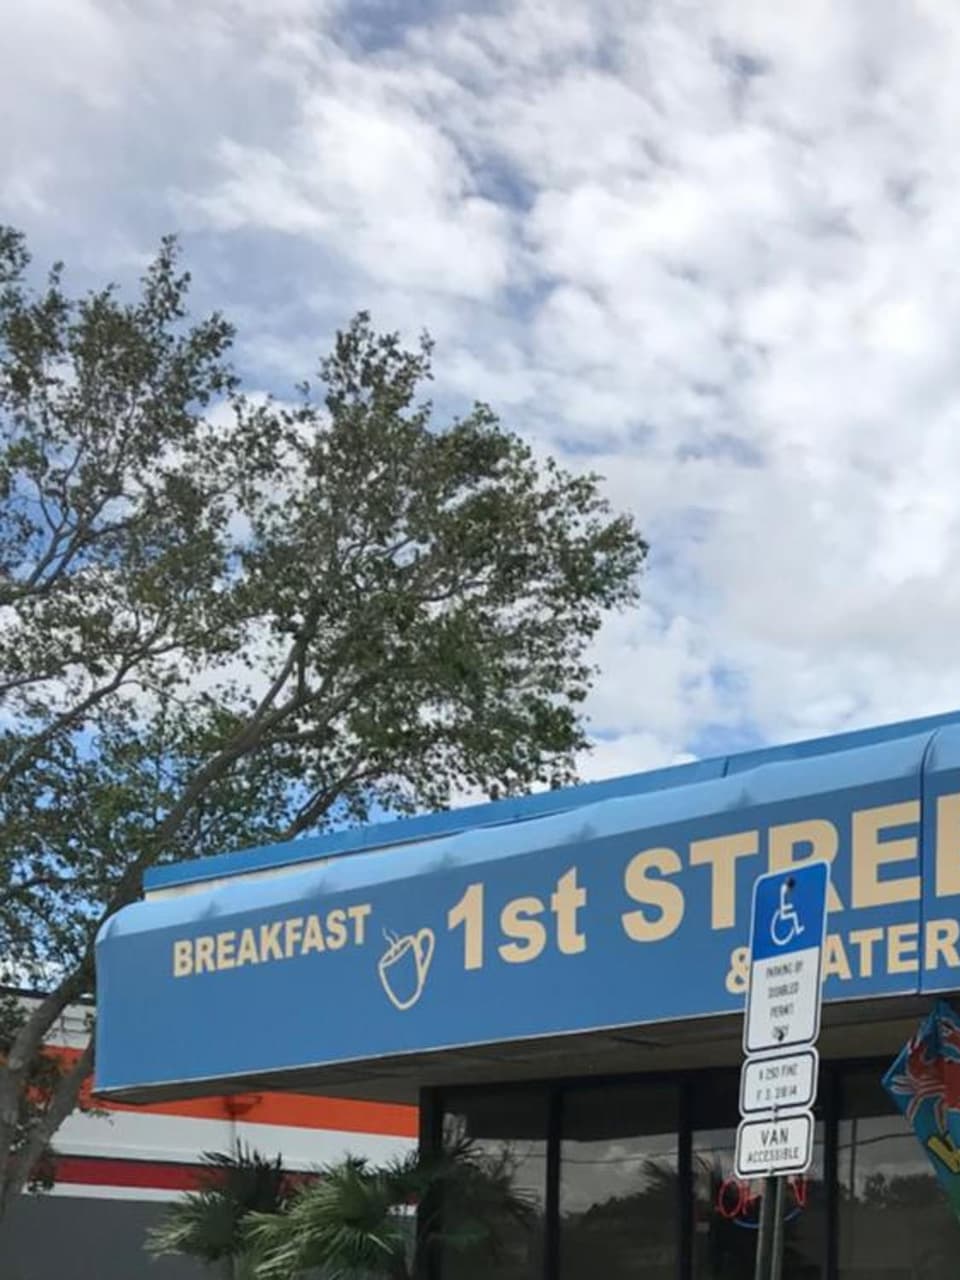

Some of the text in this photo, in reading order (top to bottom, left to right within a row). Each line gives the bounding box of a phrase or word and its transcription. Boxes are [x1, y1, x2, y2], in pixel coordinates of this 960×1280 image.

[172, 902, 372, 978] BREAKFAST
[446, 865, 588, 971] 1st
[761, 1127, 790, 1147] VAN
